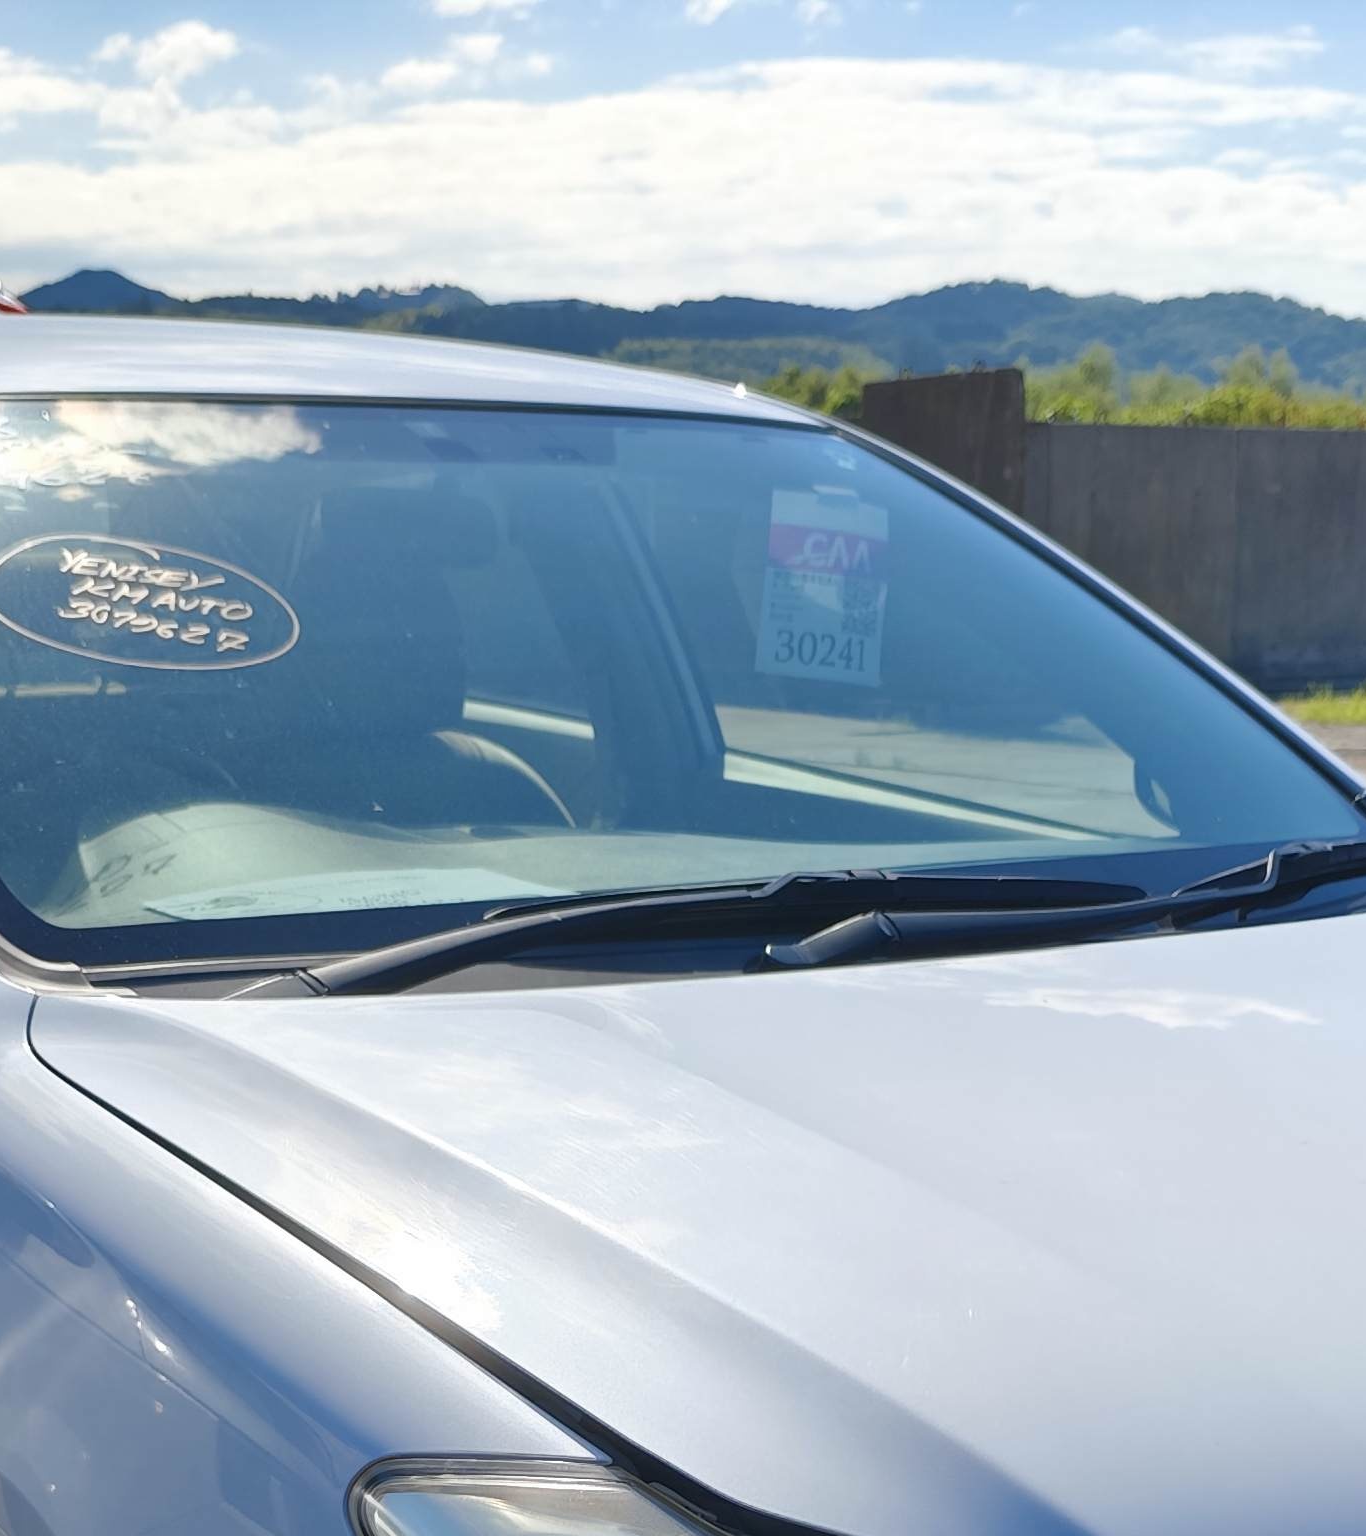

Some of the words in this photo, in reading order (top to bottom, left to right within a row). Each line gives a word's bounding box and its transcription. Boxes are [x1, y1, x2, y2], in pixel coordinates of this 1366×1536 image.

[59, 547, 226, 592] YENISEY
[151, 589, 254, 621] AUTO
[773, 629, 866, 673] 30241
